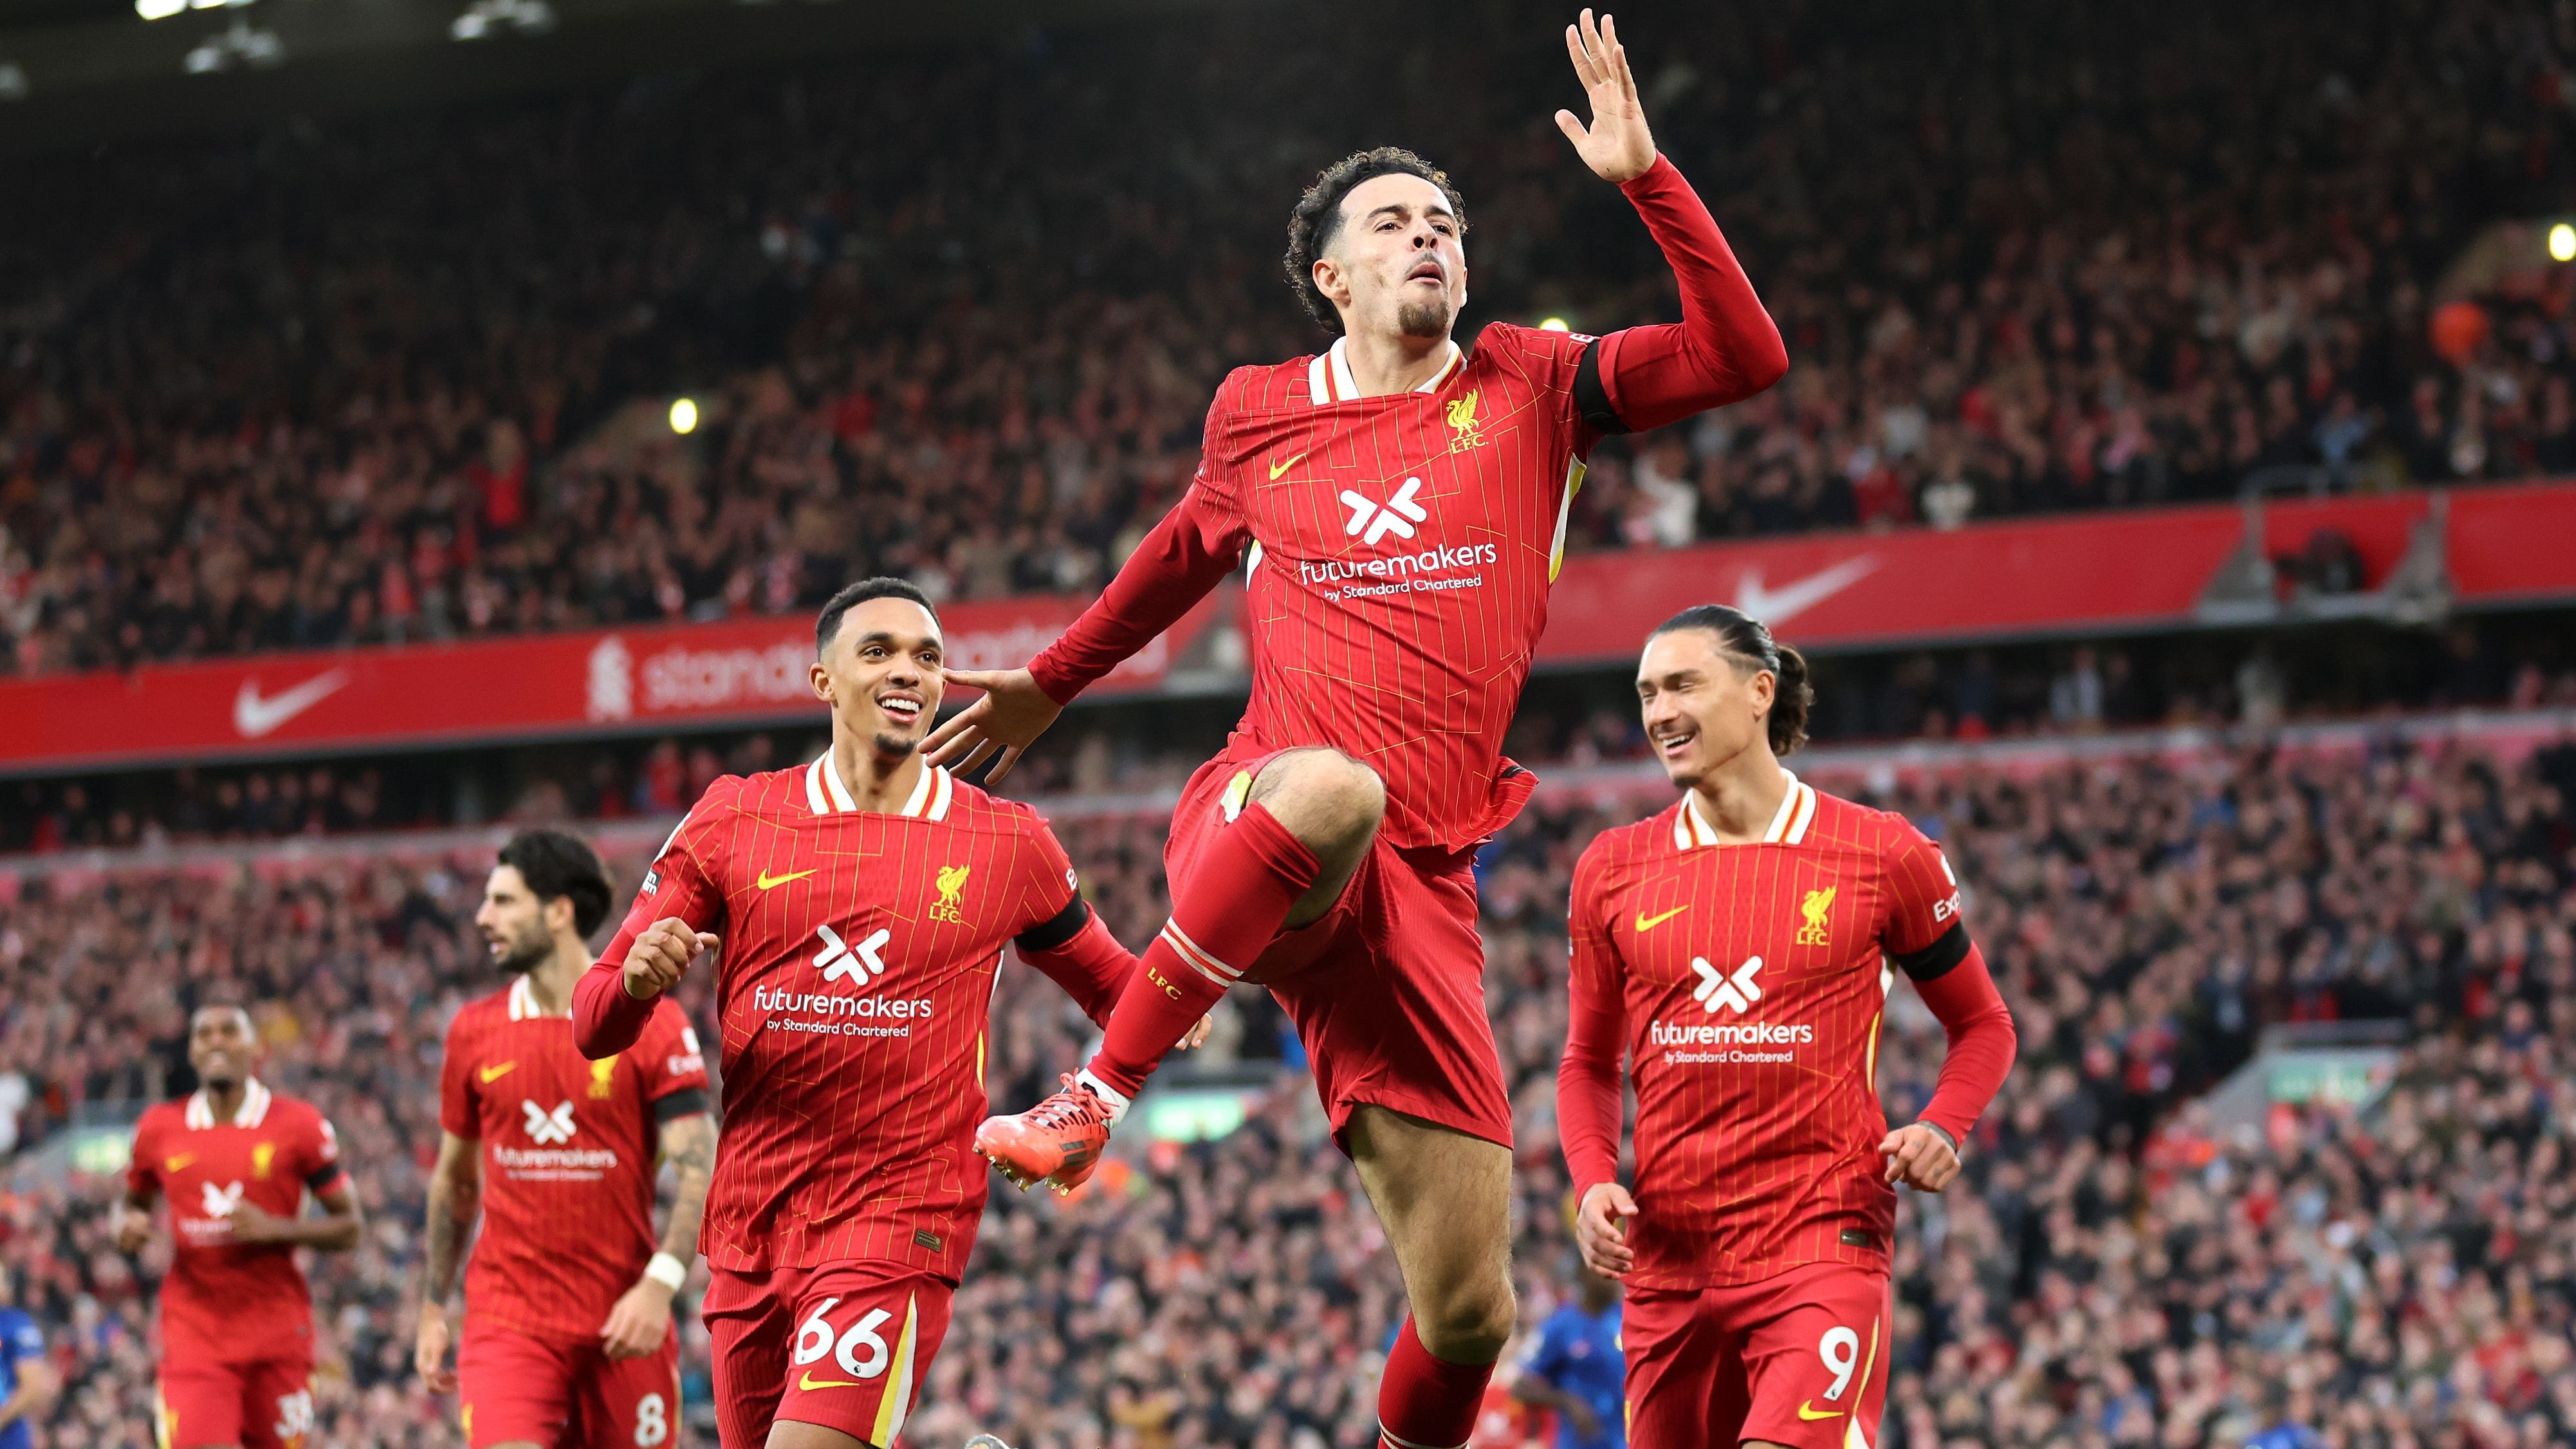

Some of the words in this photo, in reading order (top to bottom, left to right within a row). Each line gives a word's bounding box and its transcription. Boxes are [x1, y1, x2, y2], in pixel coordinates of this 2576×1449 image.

[1300, 542, 1497, 586] futuremakers
[1323, 589, 1341, 603] by
[1343, 580, 1411, 599] Standard
[1413, 573, 1482, 591] Chartered
[1147, 966, 1182, 1000] LFC
[753, 984, 932, 1019] futuremakers
[766, 1017, 781, 1032] by
[782, 1018, 840, 1035] Standard
[843, 1023, 909, 1038] Chartered
[1650, 1020, 1813, 1046] futuremakers
[1665, 1049, 1675, 1066] by
[1675, 1049, 1727, 1064] Standard
[1729, 1049, 1794, 1063] Chartered
[793, 1297, 893, 1379] 66
[1819, 1325, 1860, 1401] 9
[634, 1391, 668, 1447] 8
